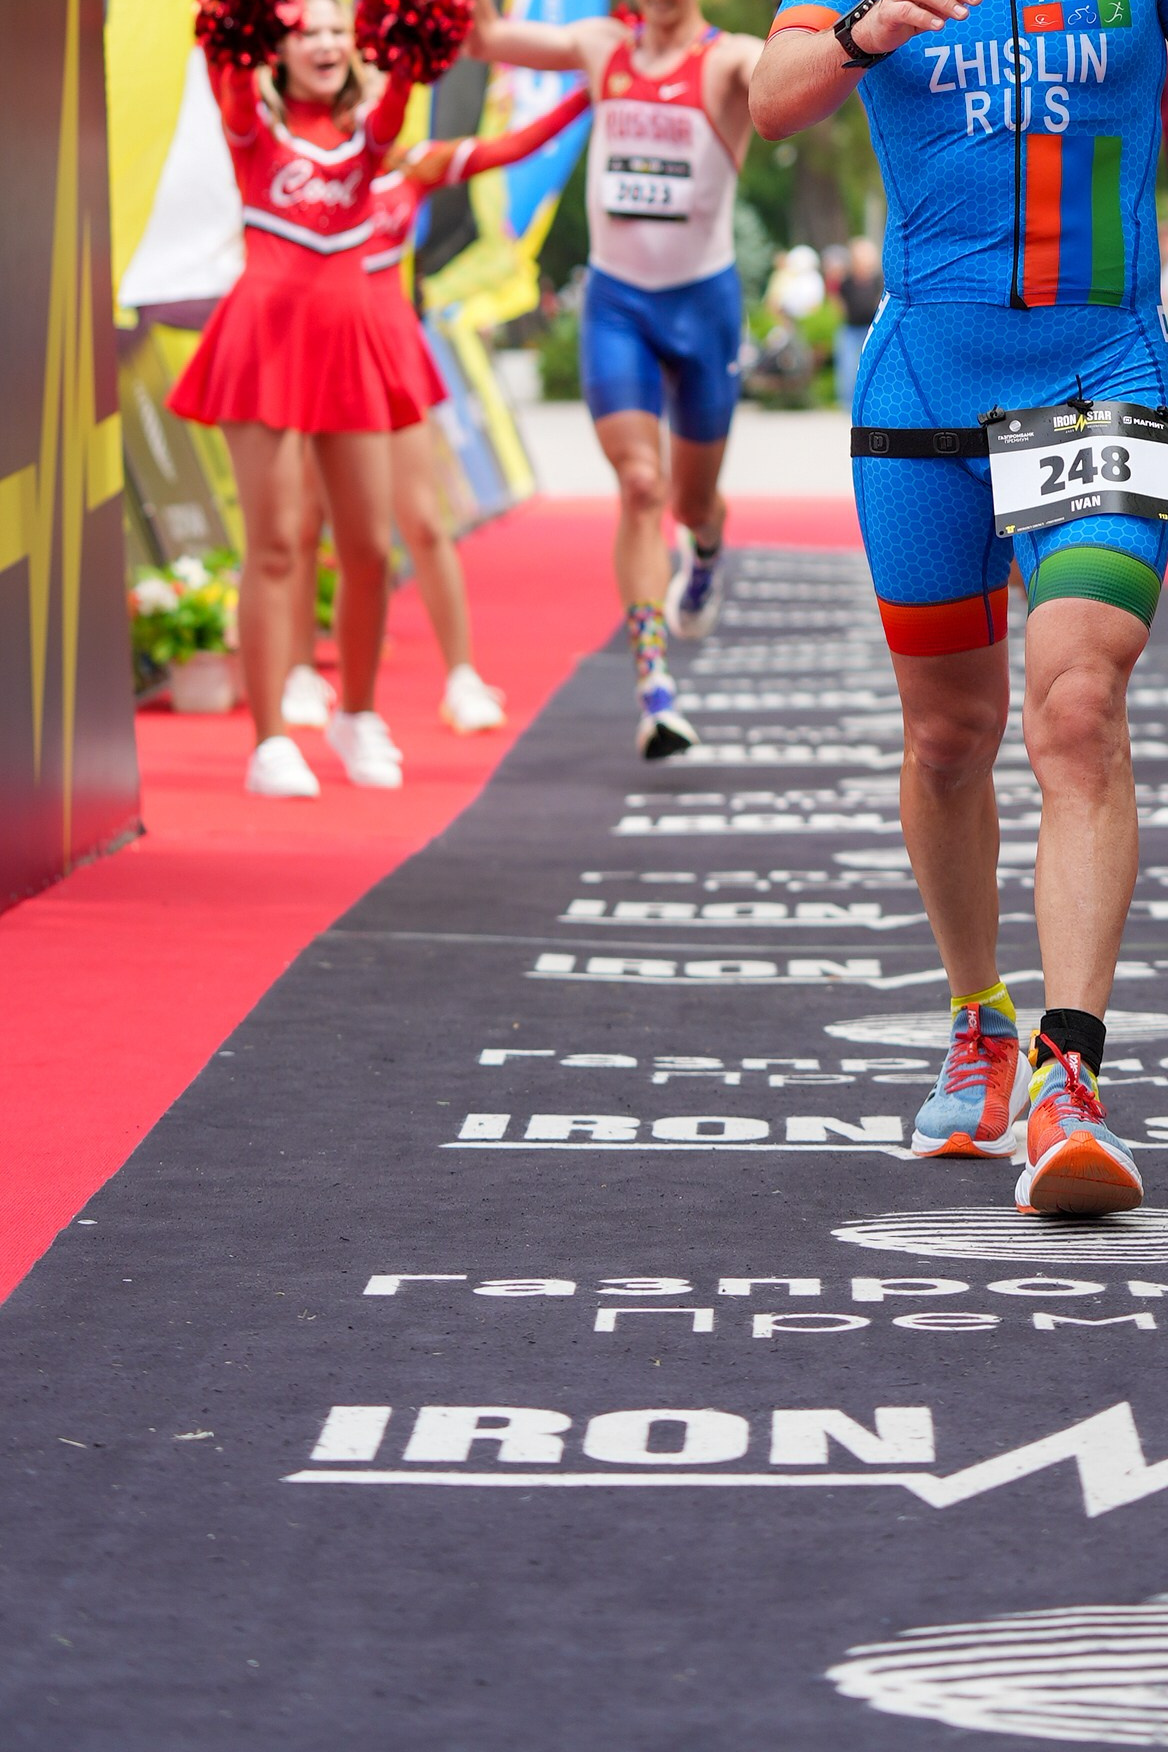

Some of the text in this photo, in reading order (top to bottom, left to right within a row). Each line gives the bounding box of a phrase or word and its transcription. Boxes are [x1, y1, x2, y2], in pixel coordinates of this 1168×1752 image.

[924, 32, 1108, 94] ZHISLIN
[965, 86, 1070, 136] RUS
[1053, 410, 1112, 429] IRON STAR
[1133, 418, 1165, 430] МАГНИТ
[1039, 445, 1132, 497] 248
[1070, 495, 1101, 512] IVAN
[532, 952, 882, 978] IRON
[457, 1113, 905, 1143] IRON
[311, 1404, 936, 1466] IRON
